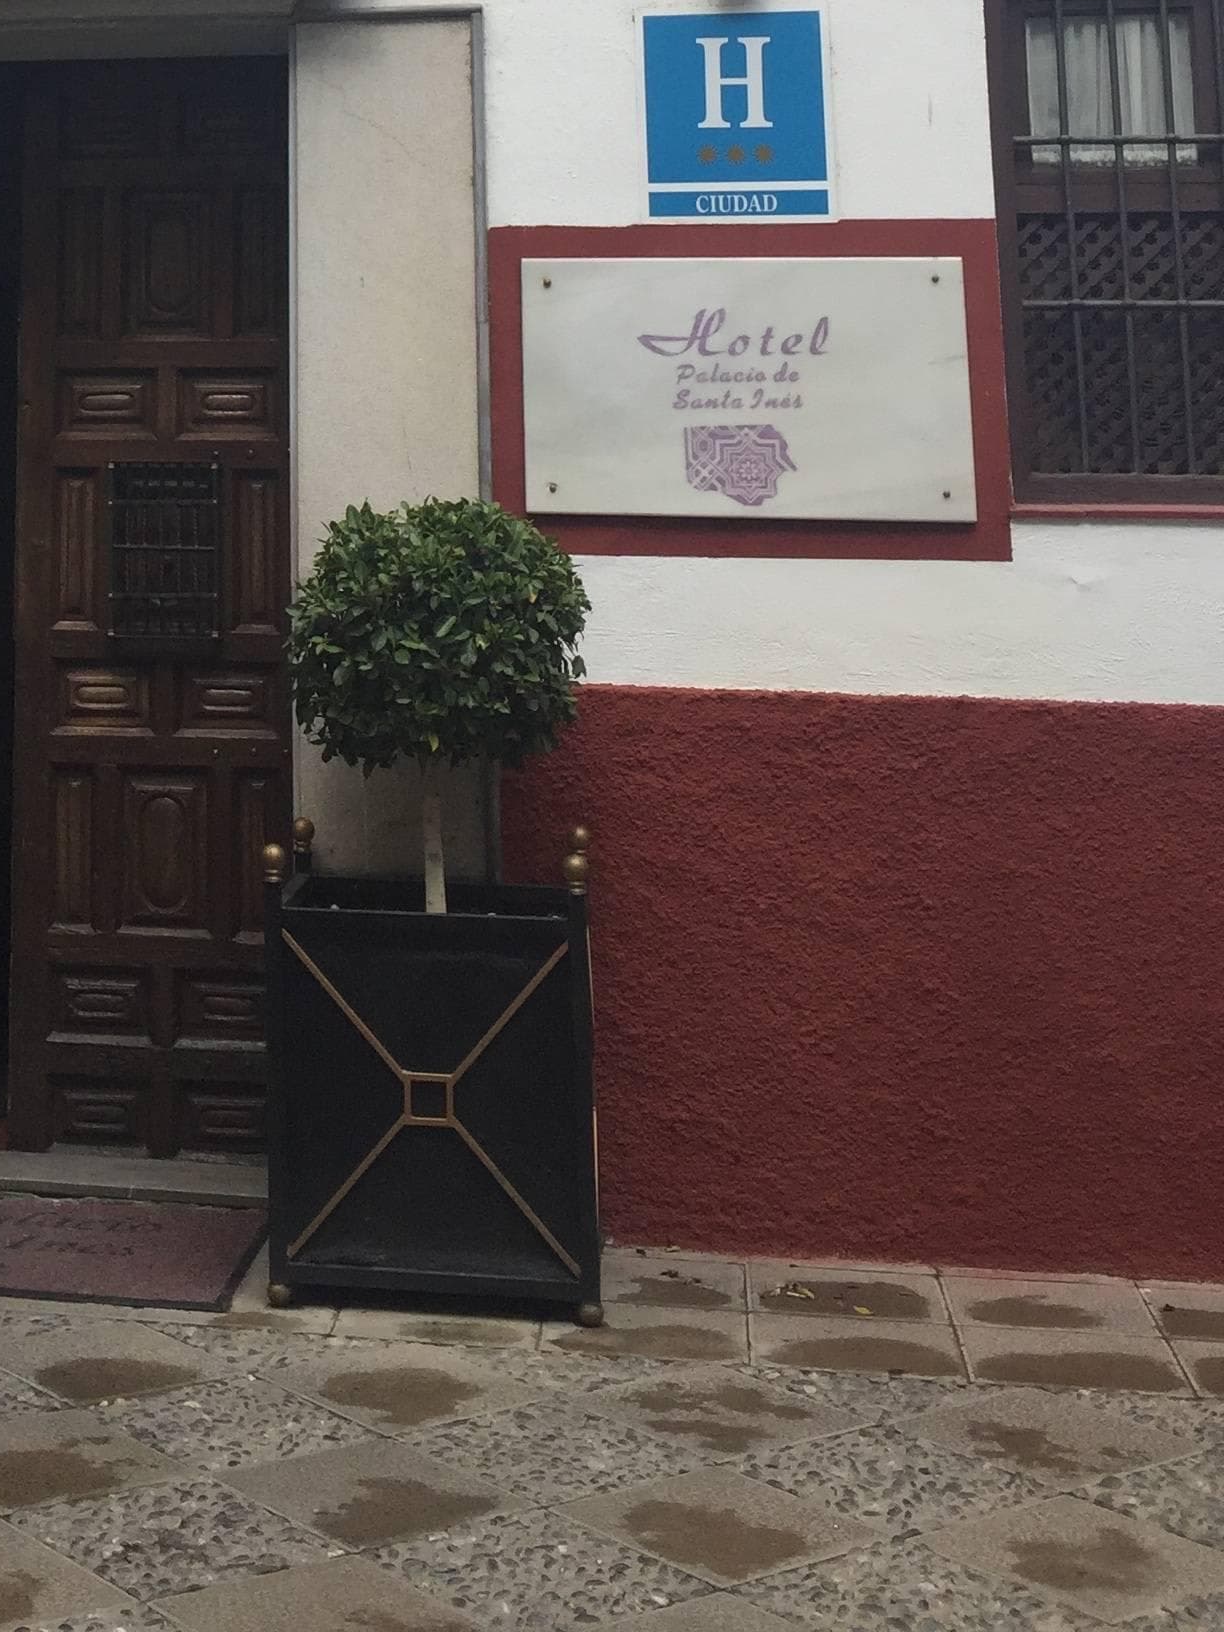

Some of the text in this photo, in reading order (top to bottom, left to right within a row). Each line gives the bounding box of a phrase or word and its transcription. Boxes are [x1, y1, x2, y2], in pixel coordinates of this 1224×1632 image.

[695, 36, 774, 129] H
[695, 193, 778, 214] CIUDAD
[636, 307, 829, 357] Hotel
[676, 361, 800, 385] Palacio de
[672, 388, 744, 410] Santa
